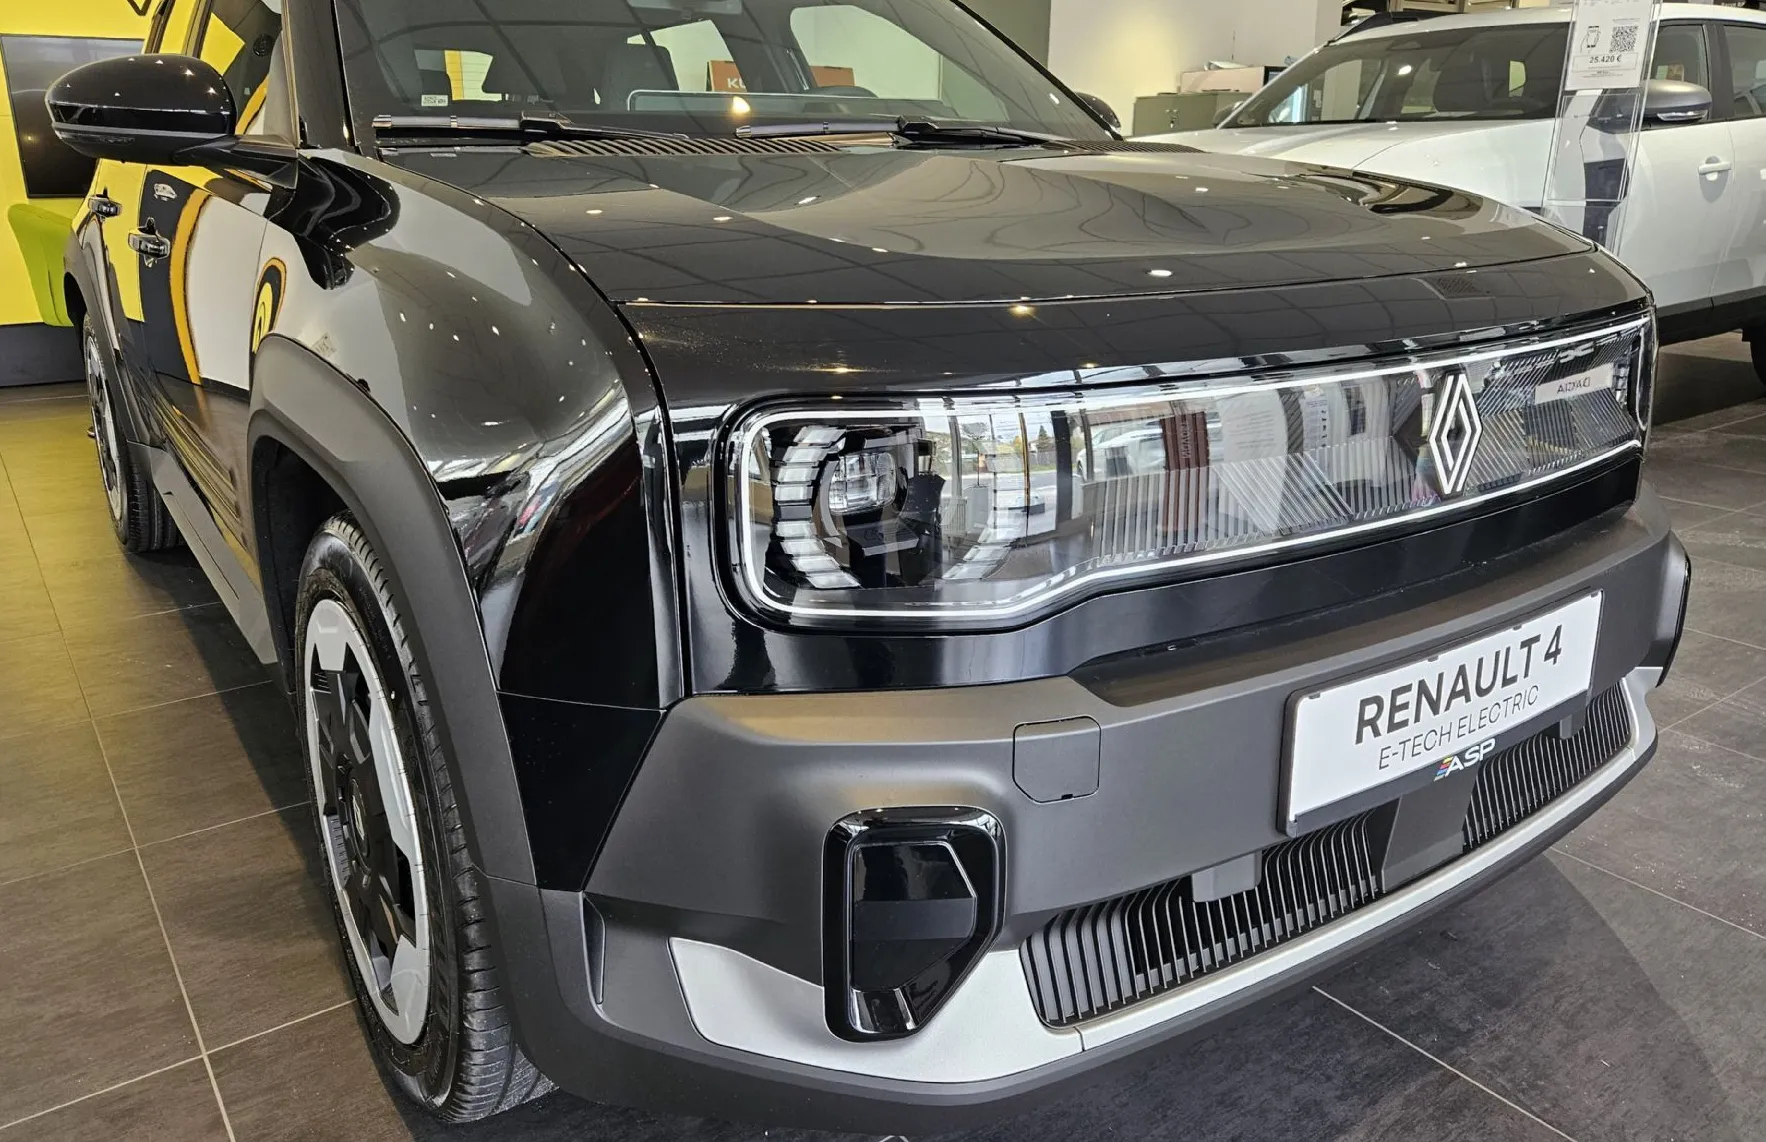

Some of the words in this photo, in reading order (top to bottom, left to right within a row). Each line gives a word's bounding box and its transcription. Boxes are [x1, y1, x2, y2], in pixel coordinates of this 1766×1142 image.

[1589, 55, 1615, 64] 25.420
[1616, 54, 1622, 63] €
[1355, 634, 1541, 745] RENAULT
[1544, 624, 1562, 666] 4
[1378, 722, 1452, 771] E-TECH
[1456, 685, 1539, 738] ELECTRIC
[1444, 738, 1495, 777] ASP
